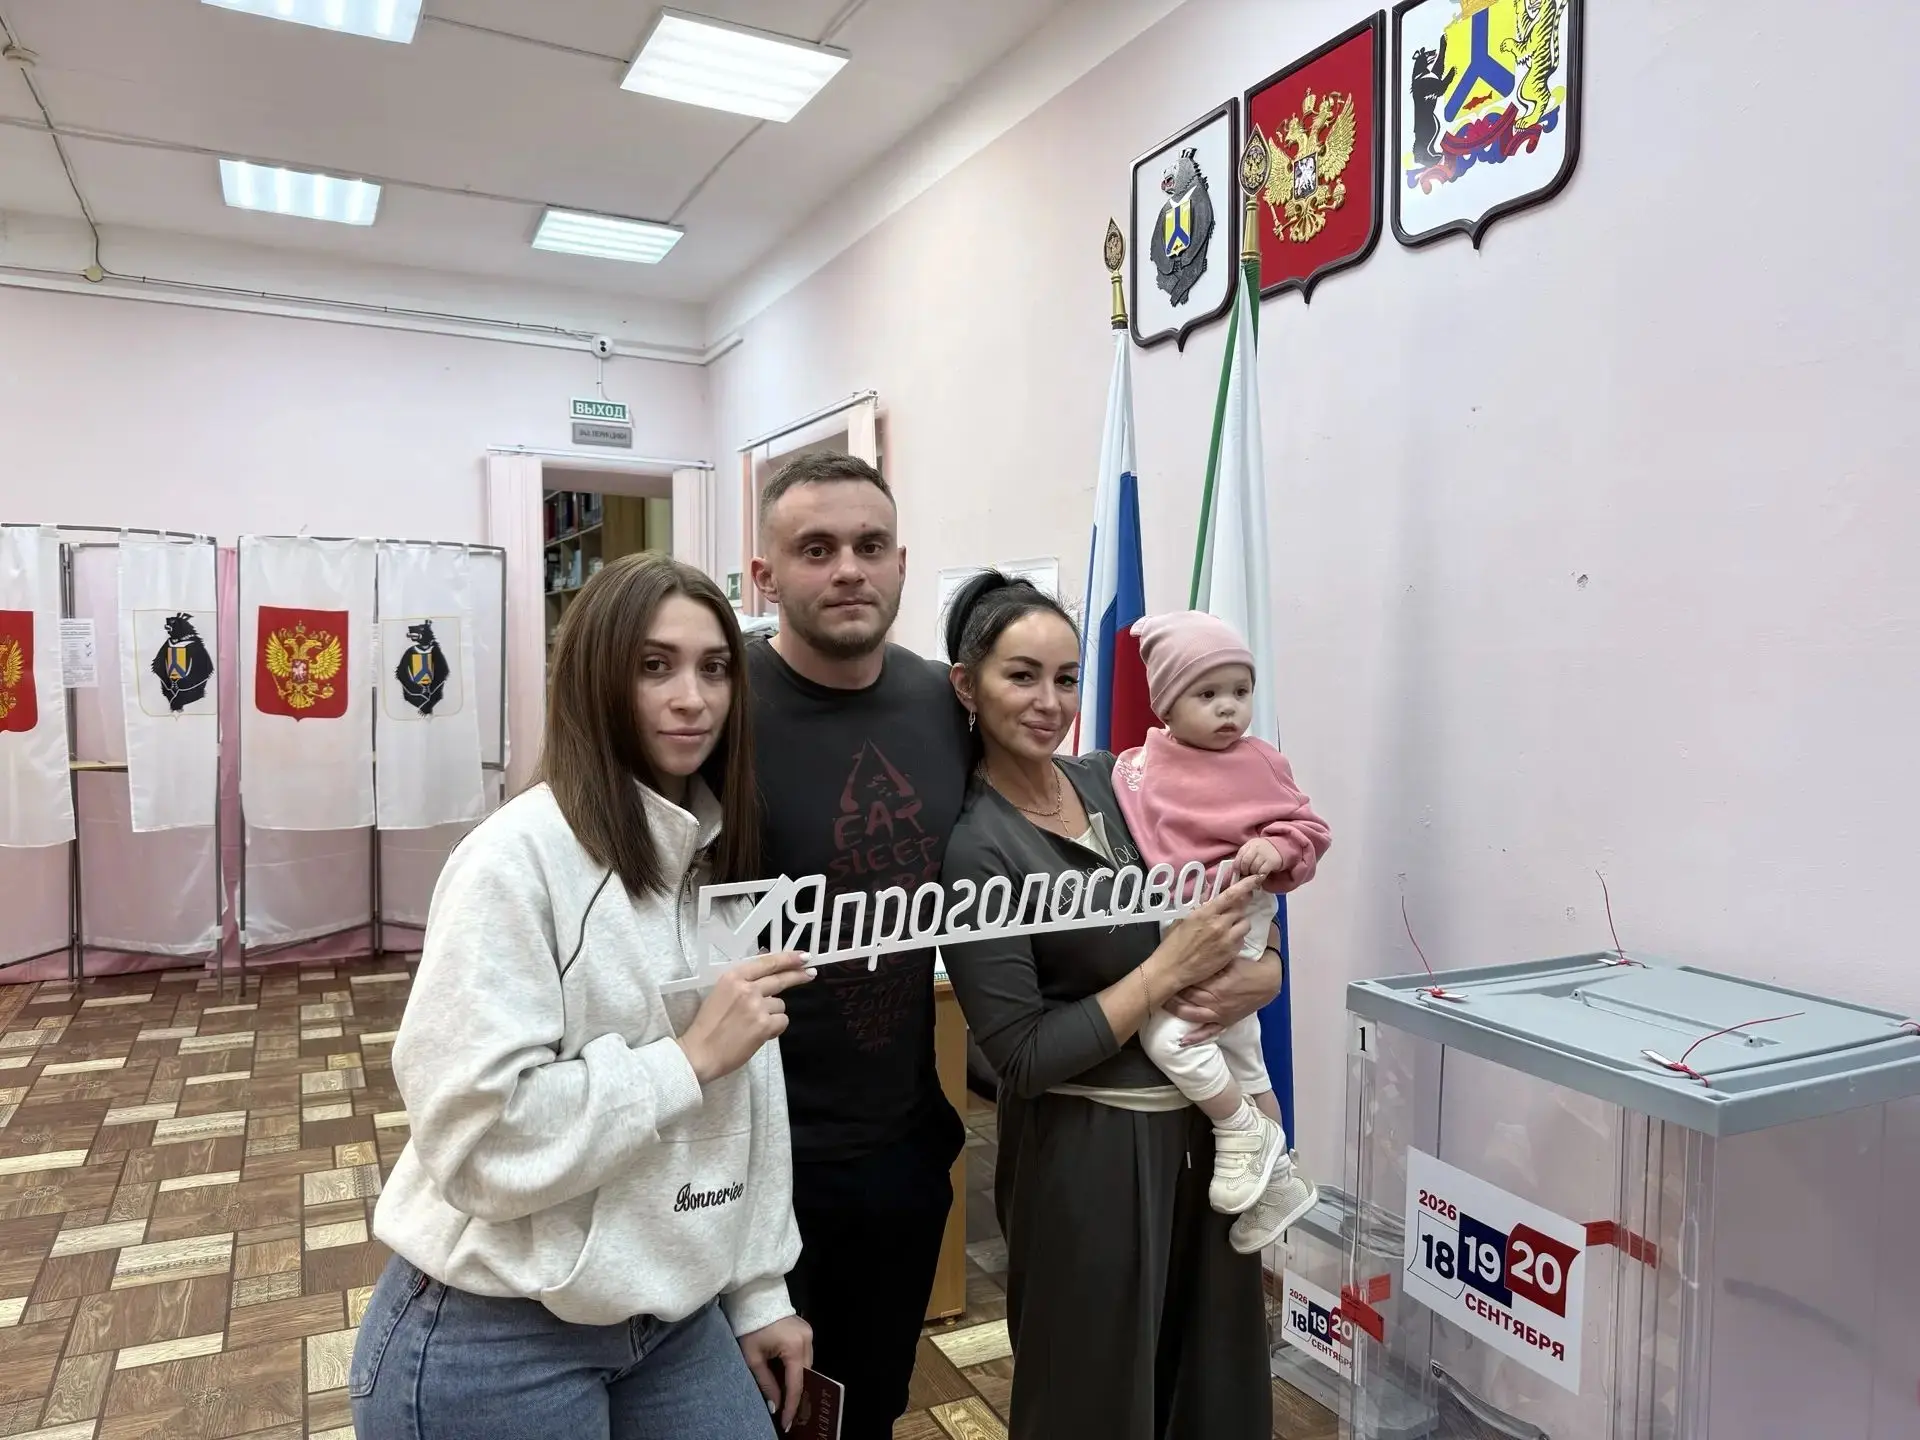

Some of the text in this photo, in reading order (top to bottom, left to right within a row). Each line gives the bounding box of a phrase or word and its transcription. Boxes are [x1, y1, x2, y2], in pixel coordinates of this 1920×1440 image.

[575, 402, 624, 419] ВЫХОД
[827, 836, 940, 884] SLEEP
[1359, 1026, 1367, 1052] 1
[1418, 1189, 1457, 1221] 2026
[1422, 1233, 1562, 1295] 18 19 20
[1289, 1288, 1308, 1305] 2026
[1290, 1310, 1353, 1341] 18 19 20
[1465, 1292, 1565, 1362] СЕНТЯБРЯ
[816, 1388, 832, 1440] АСПОРТ
